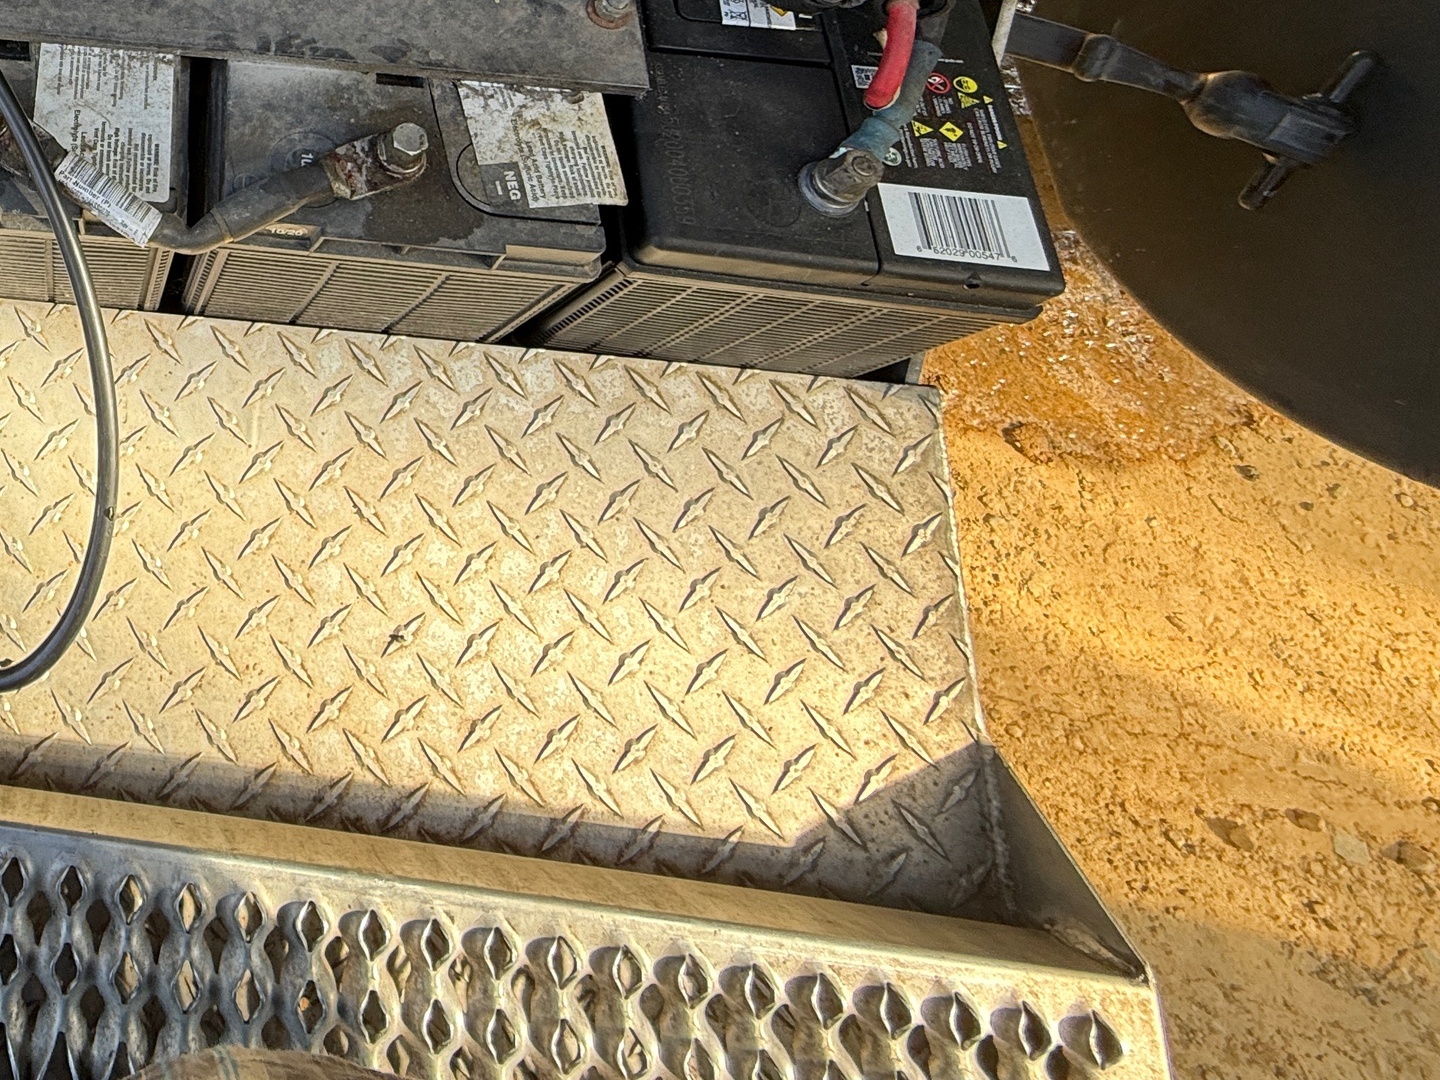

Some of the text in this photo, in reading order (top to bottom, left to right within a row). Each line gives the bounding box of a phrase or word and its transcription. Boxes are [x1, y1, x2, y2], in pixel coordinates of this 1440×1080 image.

[57, 169, 73, 182] Part
[72, 180, 102, 201] Number
[503, 169, 521, 201] NEG
[534, 174, 547, 199] Battery
[270, 227, 303, 236] 10/20
